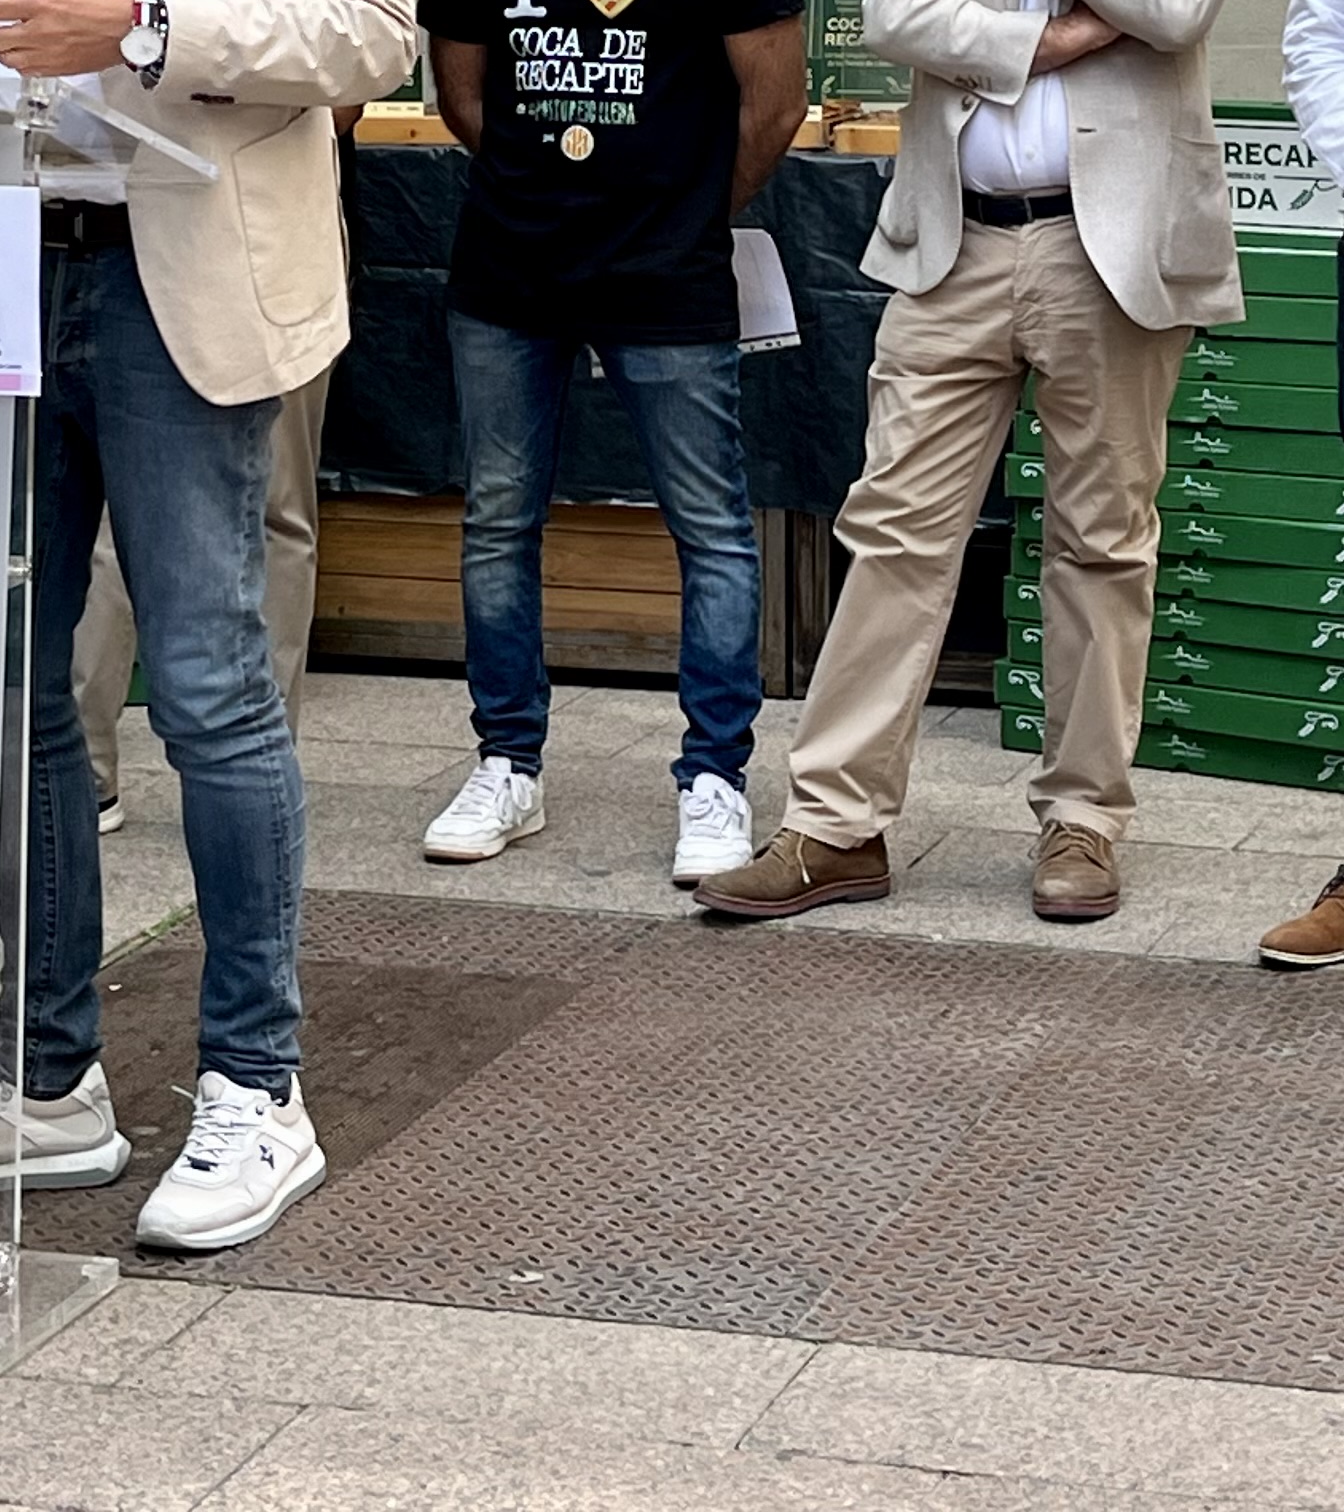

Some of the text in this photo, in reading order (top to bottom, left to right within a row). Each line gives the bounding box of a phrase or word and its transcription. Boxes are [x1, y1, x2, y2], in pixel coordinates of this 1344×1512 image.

[826, 17, 865, 31] COC
[509, 27, 647, 60] COCA DE
[516, 59, 644, 94] RECAPTE
[1224, 141, 1318, 168] RECA
